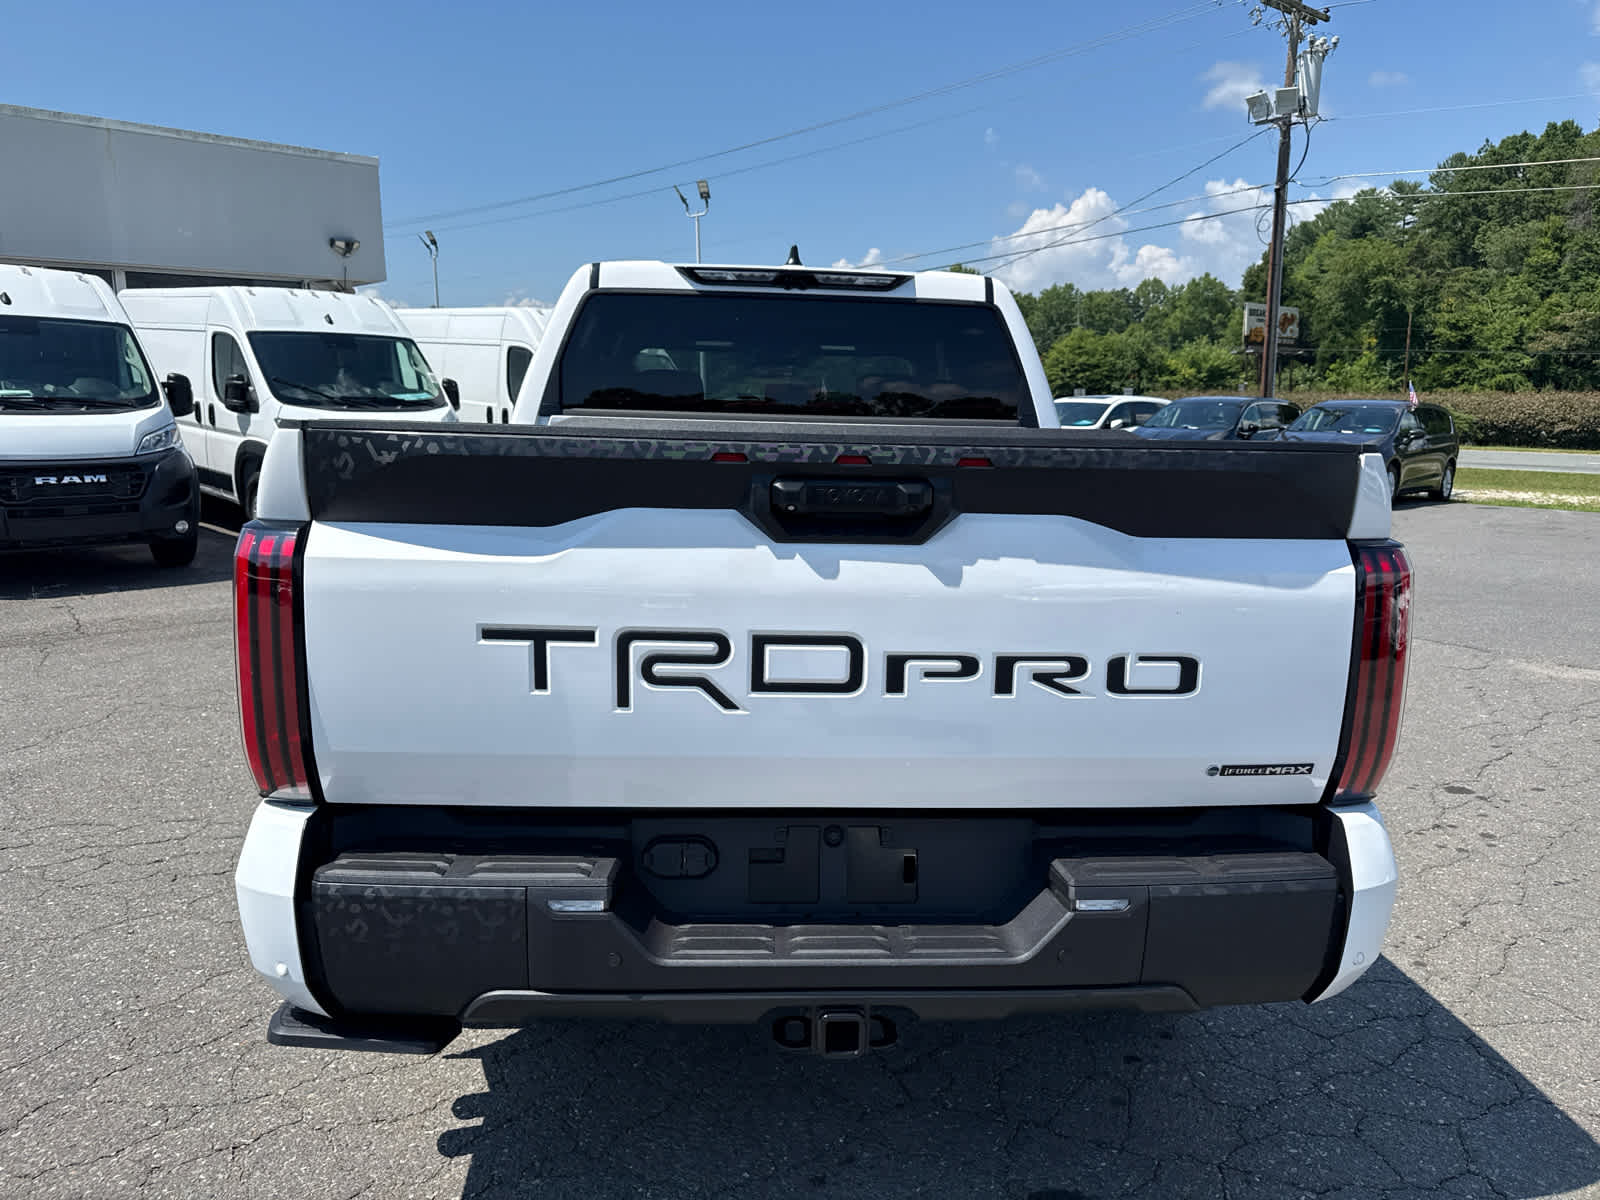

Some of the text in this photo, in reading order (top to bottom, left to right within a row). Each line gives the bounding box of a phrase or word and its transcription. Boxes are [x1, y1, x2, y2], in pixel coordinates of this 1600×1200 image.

[34, 474, 107, 486] RAM
[476, 623, 1202, 714] TRD PRO
